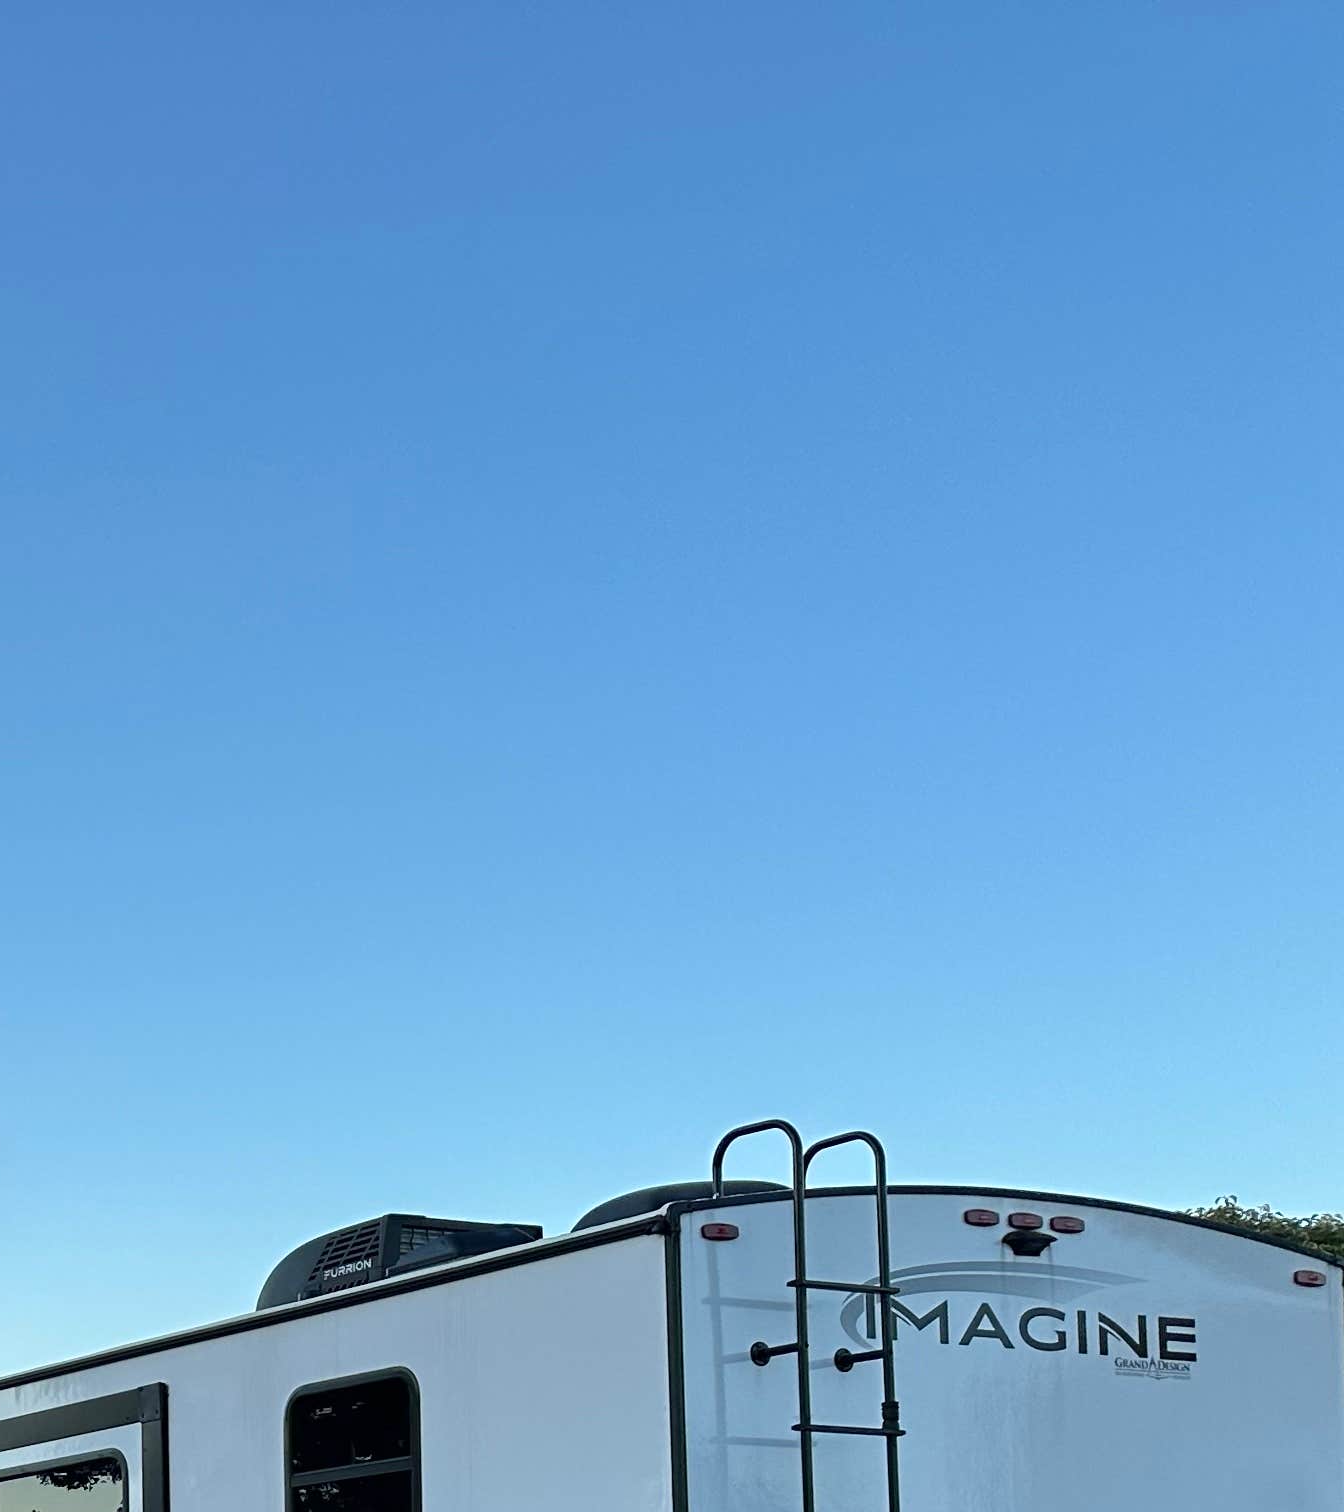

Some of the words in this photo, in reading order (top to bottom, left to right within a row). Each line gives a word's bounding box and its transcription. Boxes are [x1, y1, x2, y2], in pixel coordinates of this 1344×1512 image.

[324, 1257, 372, 1281] FURRION
[865, 1290, 1198, 1362] IMAGINE
[1114, 1356, 1149, 1369] GRAND
[1157, 1359, 1192, 1373] DESIGN
